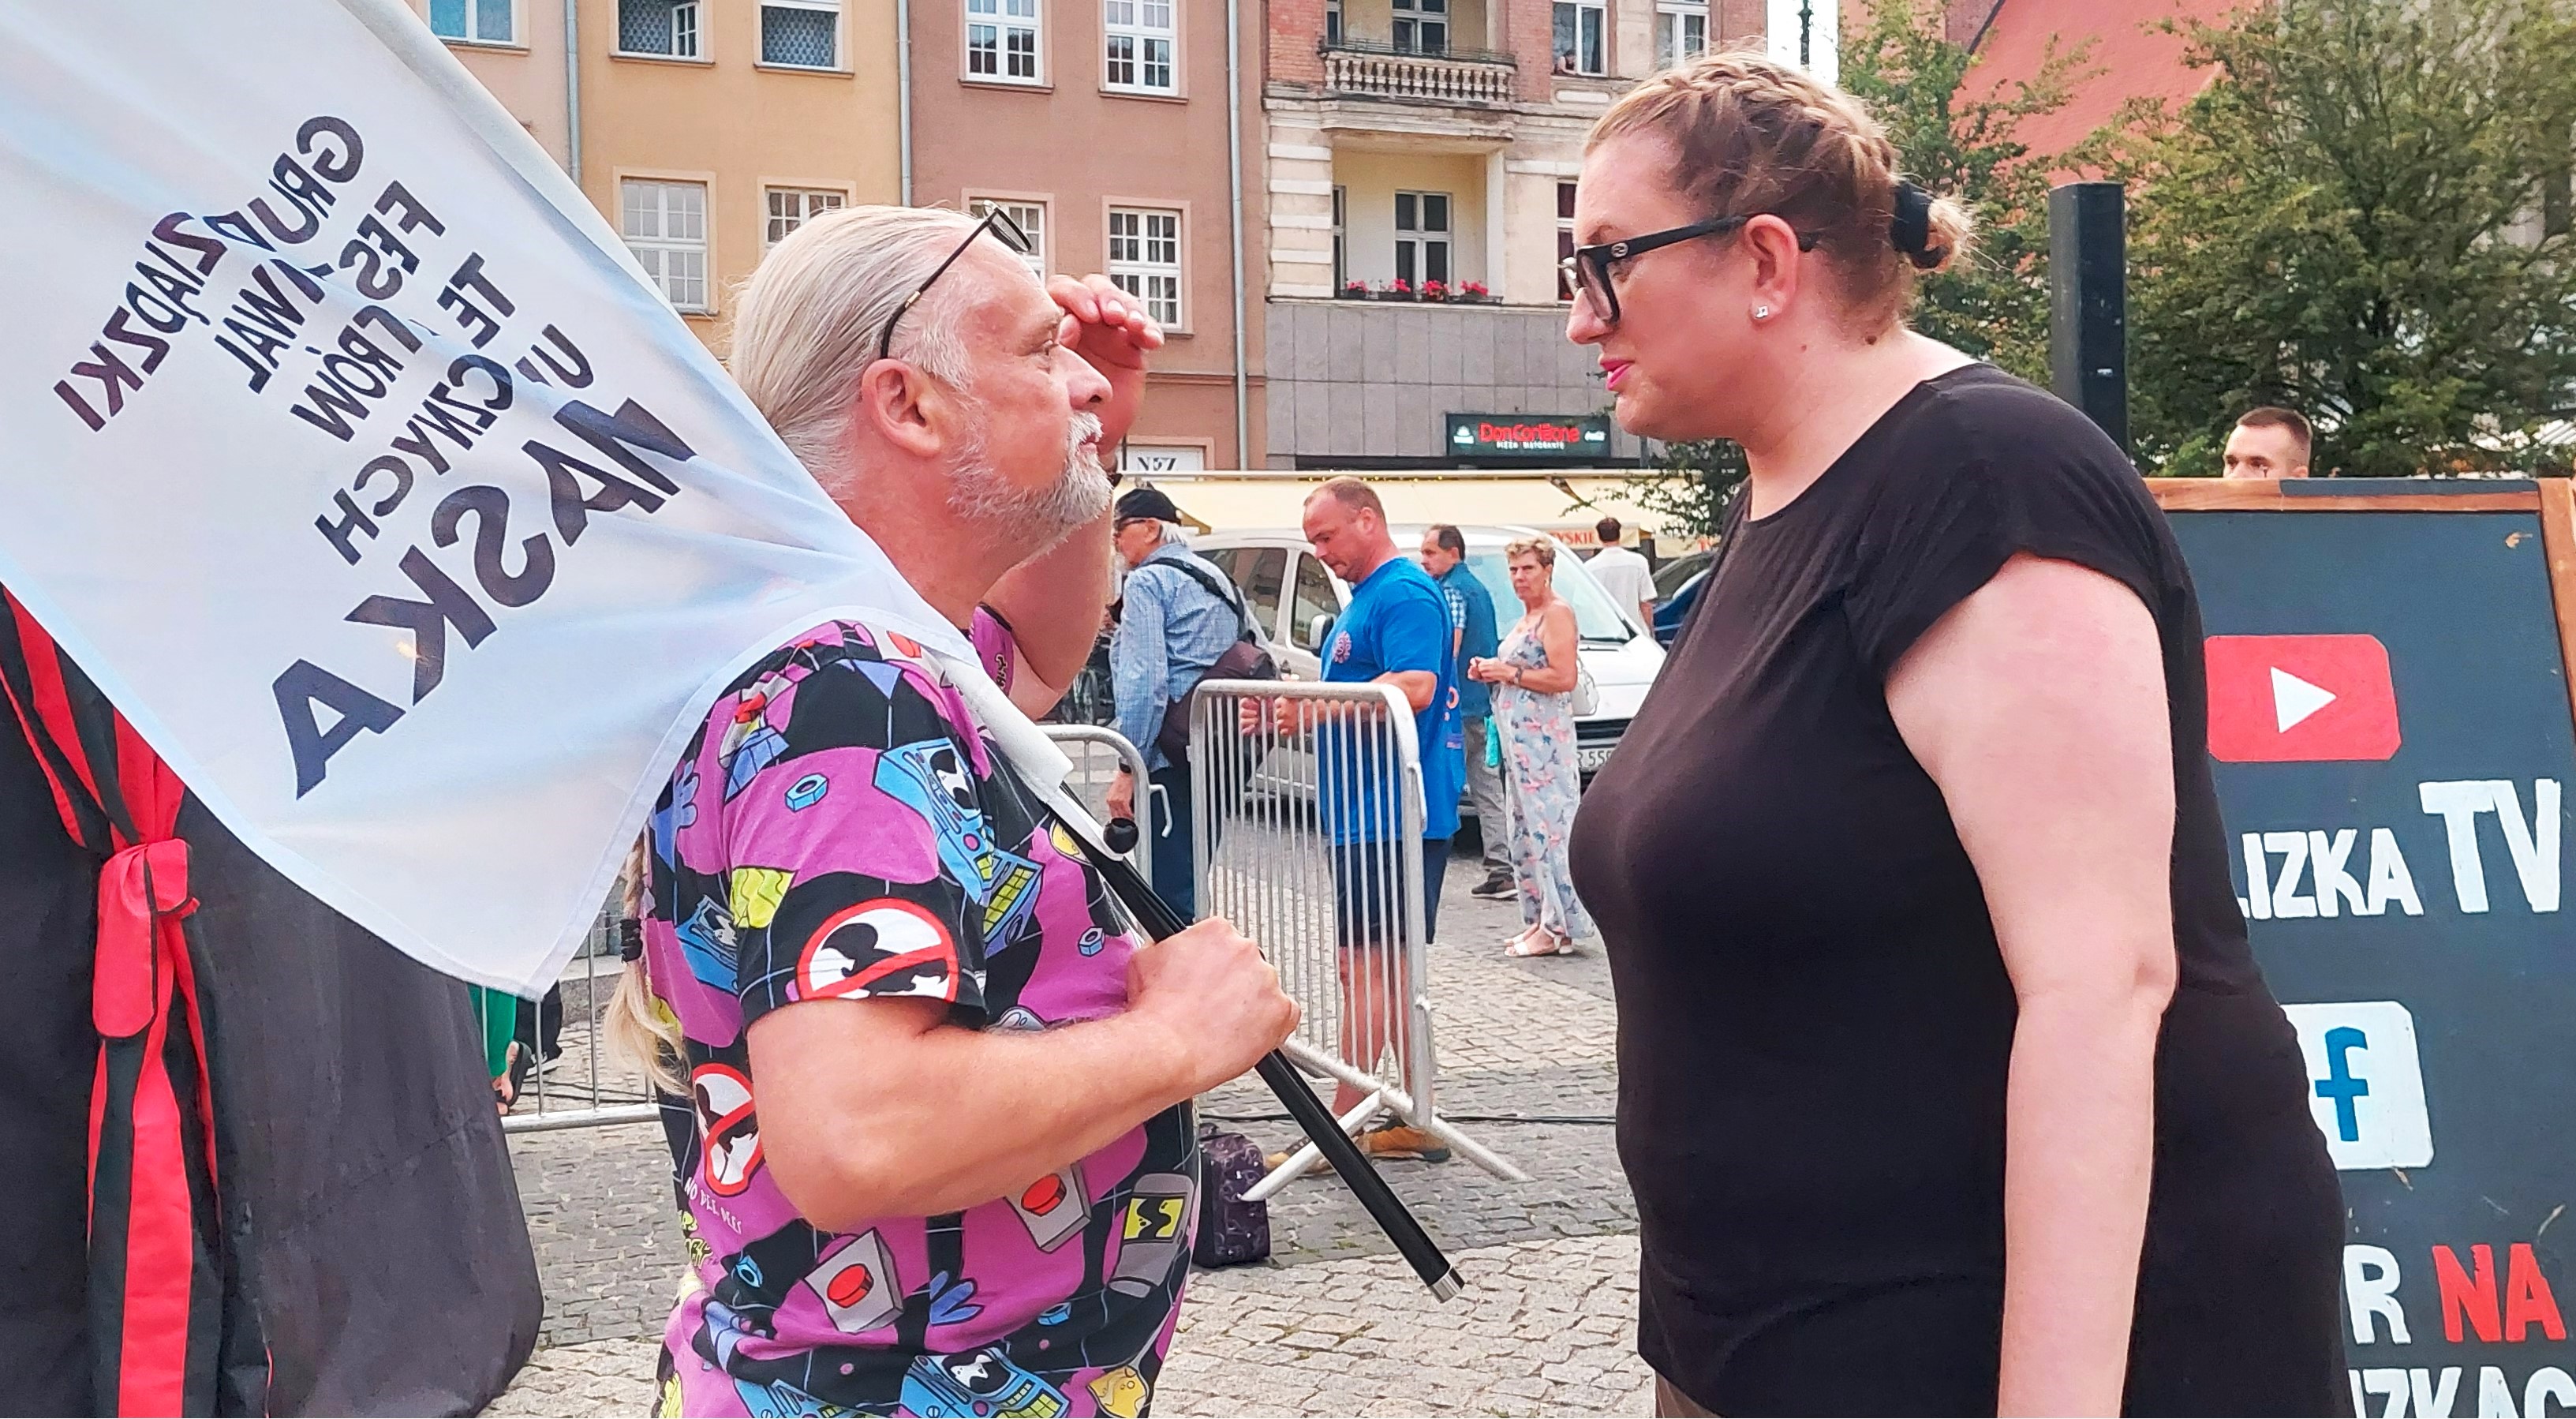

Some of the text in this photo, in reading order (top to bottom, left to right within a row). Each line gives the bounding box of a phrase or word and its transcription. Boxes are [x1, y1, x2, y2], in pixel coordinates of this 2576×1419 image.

[2238, 778, 2562, 919] IZKA TV
[684, 1176, 698, 1200] NO
[2432, 1243, 2567, 1342] NA
